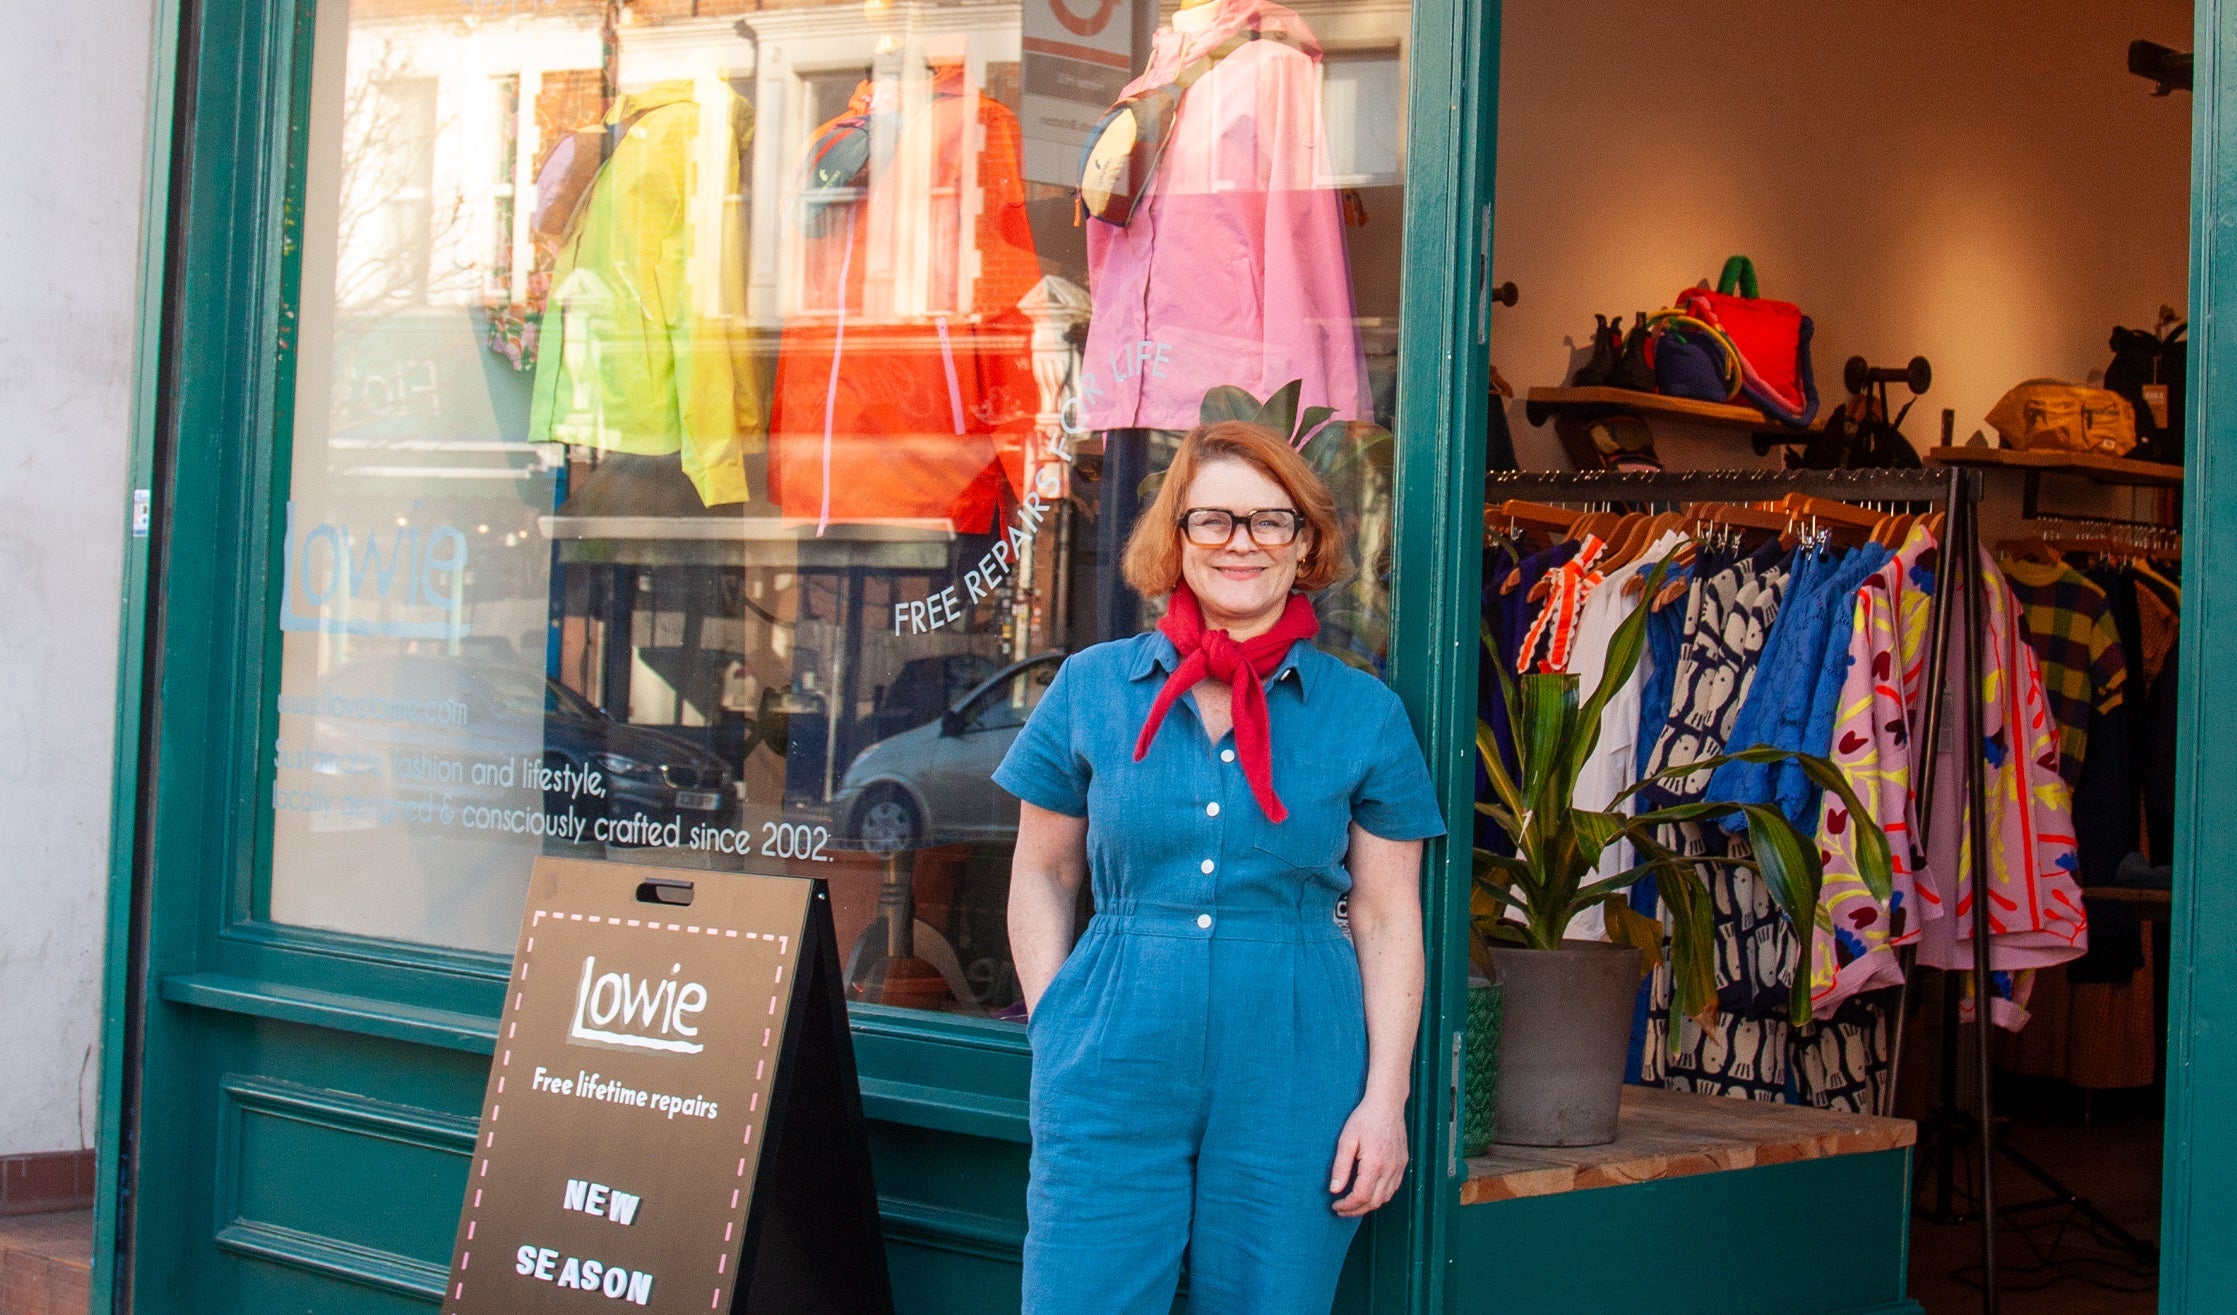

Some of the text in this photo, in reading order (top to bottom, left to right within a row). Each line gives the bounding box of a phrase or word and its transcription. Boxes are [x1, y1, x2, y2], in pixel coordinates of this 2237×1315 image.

[894, 340, 1172, 637] FREE REPAIRS FOR LIFE
[392, 748, 464, 784] fashion
[471, 750, 515, 787] and
[522, 760, 608, 799] lifestyle,
[439, 793, 455, 826] &
[462, 800, 587, 846] consciously
[594, 811, 681, 849] crafted
[689, 822, 751, 856] since
[761, 821, 835, 862] 2002.
[570, 954, 708, 1055] Lowie
[531, 1066, 719, 1120] Free lifetime repairs
[562, 1178, 641, 1226] NEW
[515, 1243, 654, 1307] SEASON
